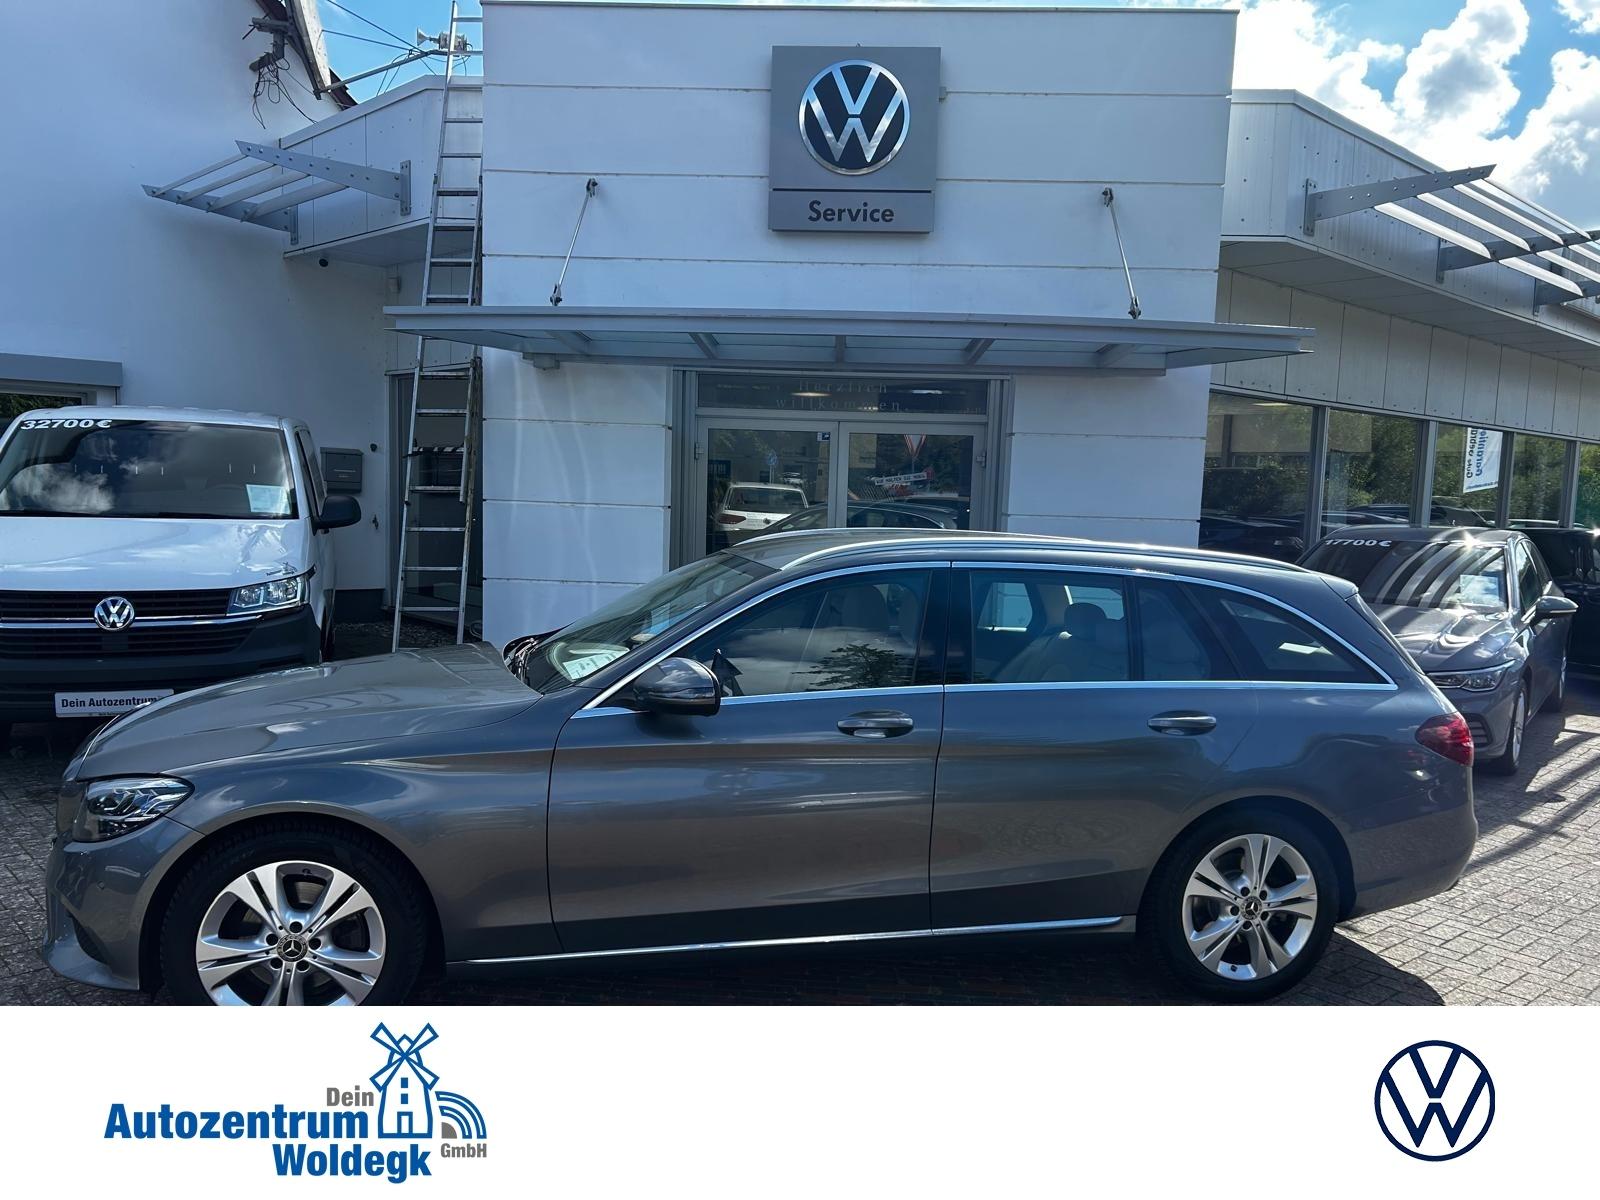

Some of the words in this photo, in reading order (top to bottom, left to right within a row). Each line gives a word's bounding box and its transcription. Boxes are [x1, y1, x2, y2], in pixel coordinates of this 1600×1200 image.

[799, 59, 910, 175] VW
[808, 199, 894, 222] Service
[61, 698, 86, 708] Dein
